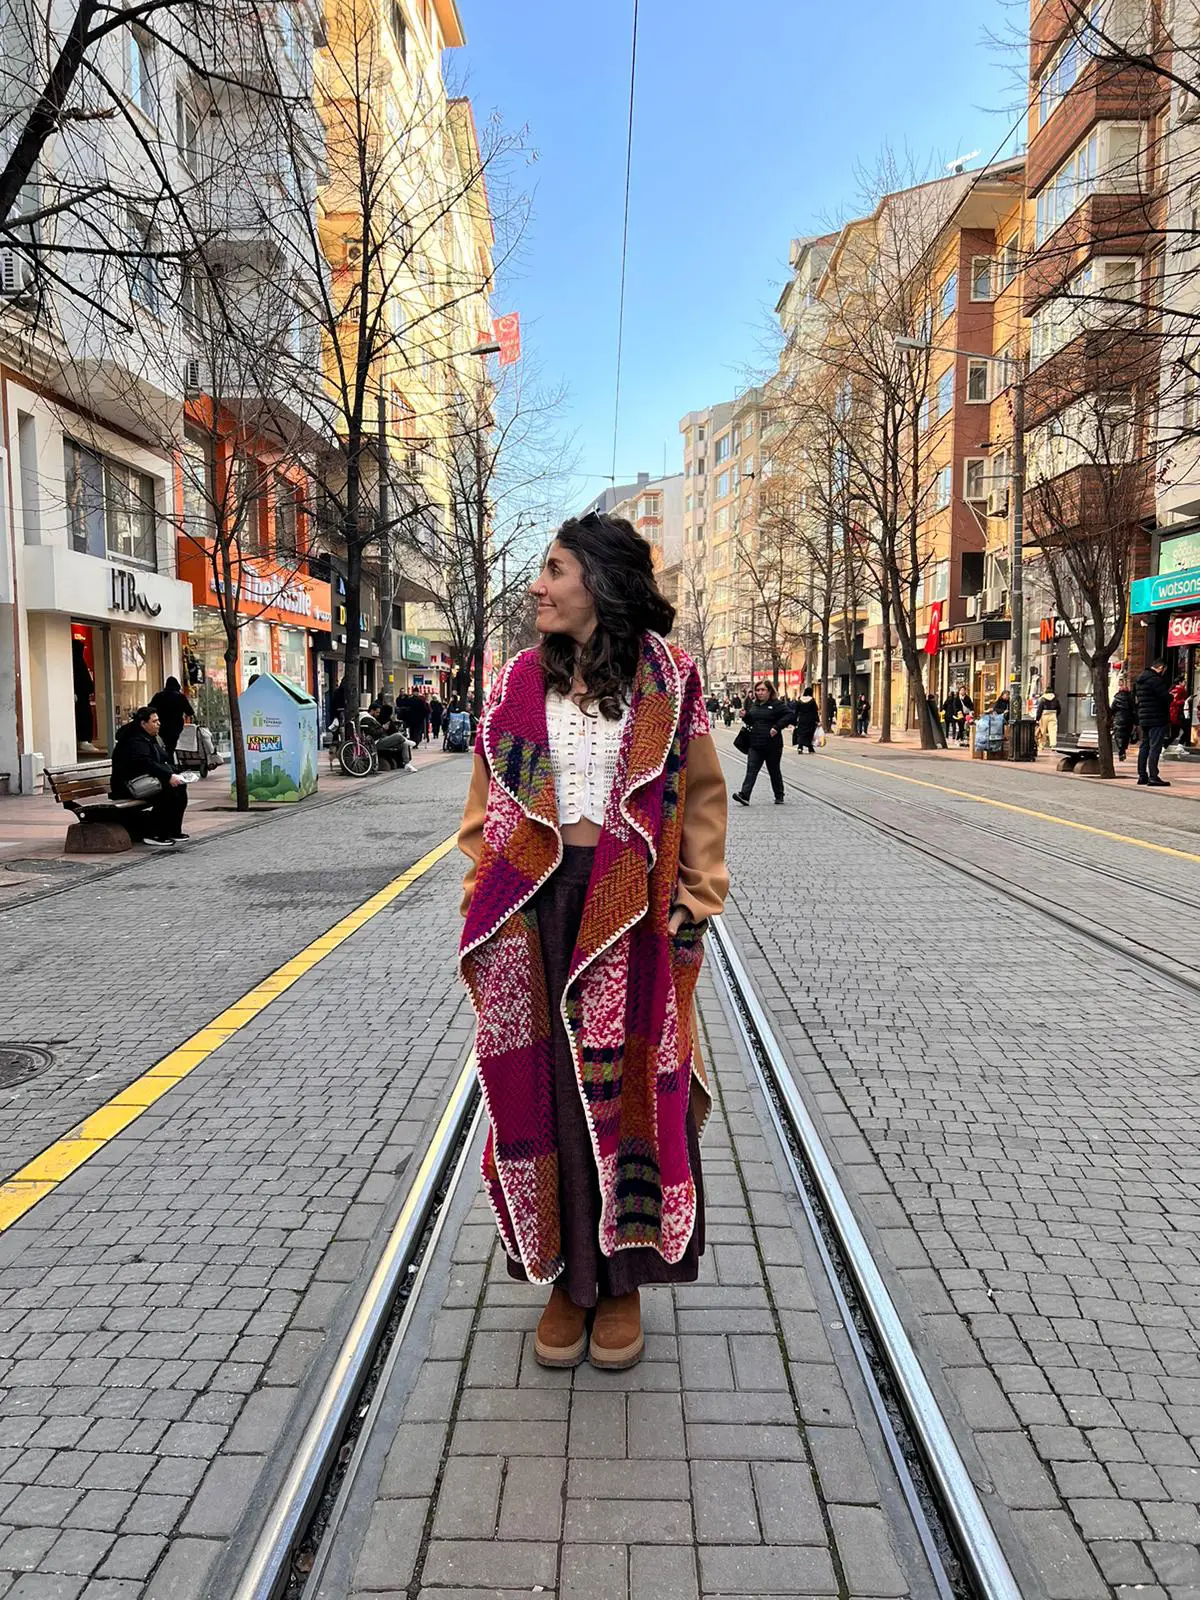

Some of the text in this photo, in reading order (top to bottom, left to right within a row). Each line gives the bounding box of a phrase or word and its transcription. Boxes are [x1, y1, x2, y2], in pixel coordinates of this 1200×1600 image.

[111, 567, 137, 612] LTB
[1158, 580, 1200, 598] watsons
[1055, 617, 1083, 637] STRET
